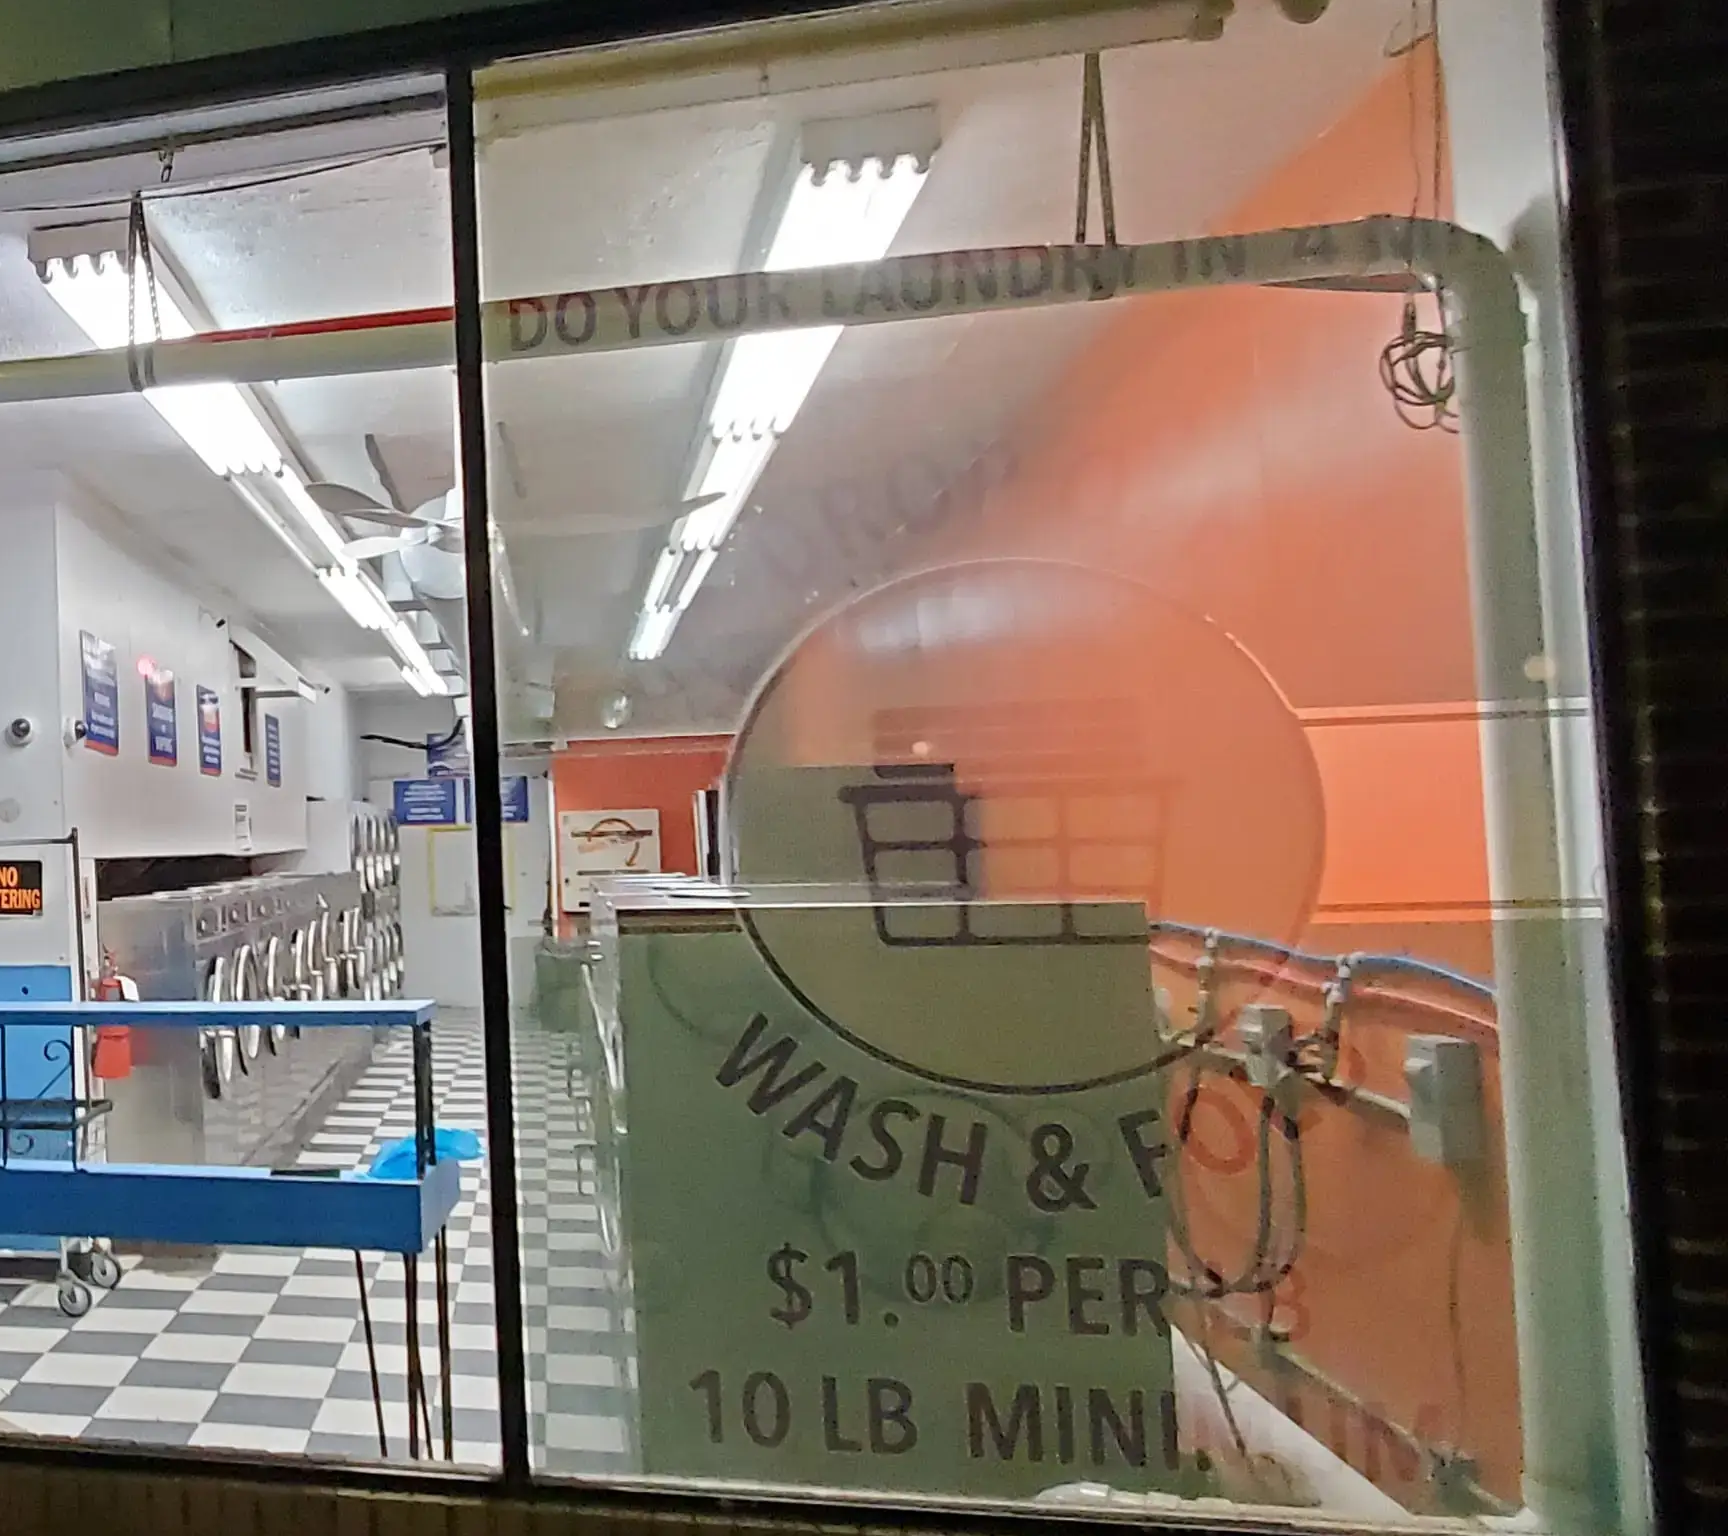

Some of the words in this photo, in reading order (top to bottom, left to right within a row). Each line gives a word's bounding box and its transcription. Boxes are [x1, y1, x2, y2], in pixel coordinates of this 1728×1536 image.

[509, 293, 597, 351] DO
[612, 270, 790, 339] YOUR
[715, 1012, 988, 1205] WASH
[1025, 1122, 1098, 1213] &
[1008, 1253, 1171, 1338] PER
[688, 1369, 791, 1448] 10
[821, 1374, 919, 1455] LB
